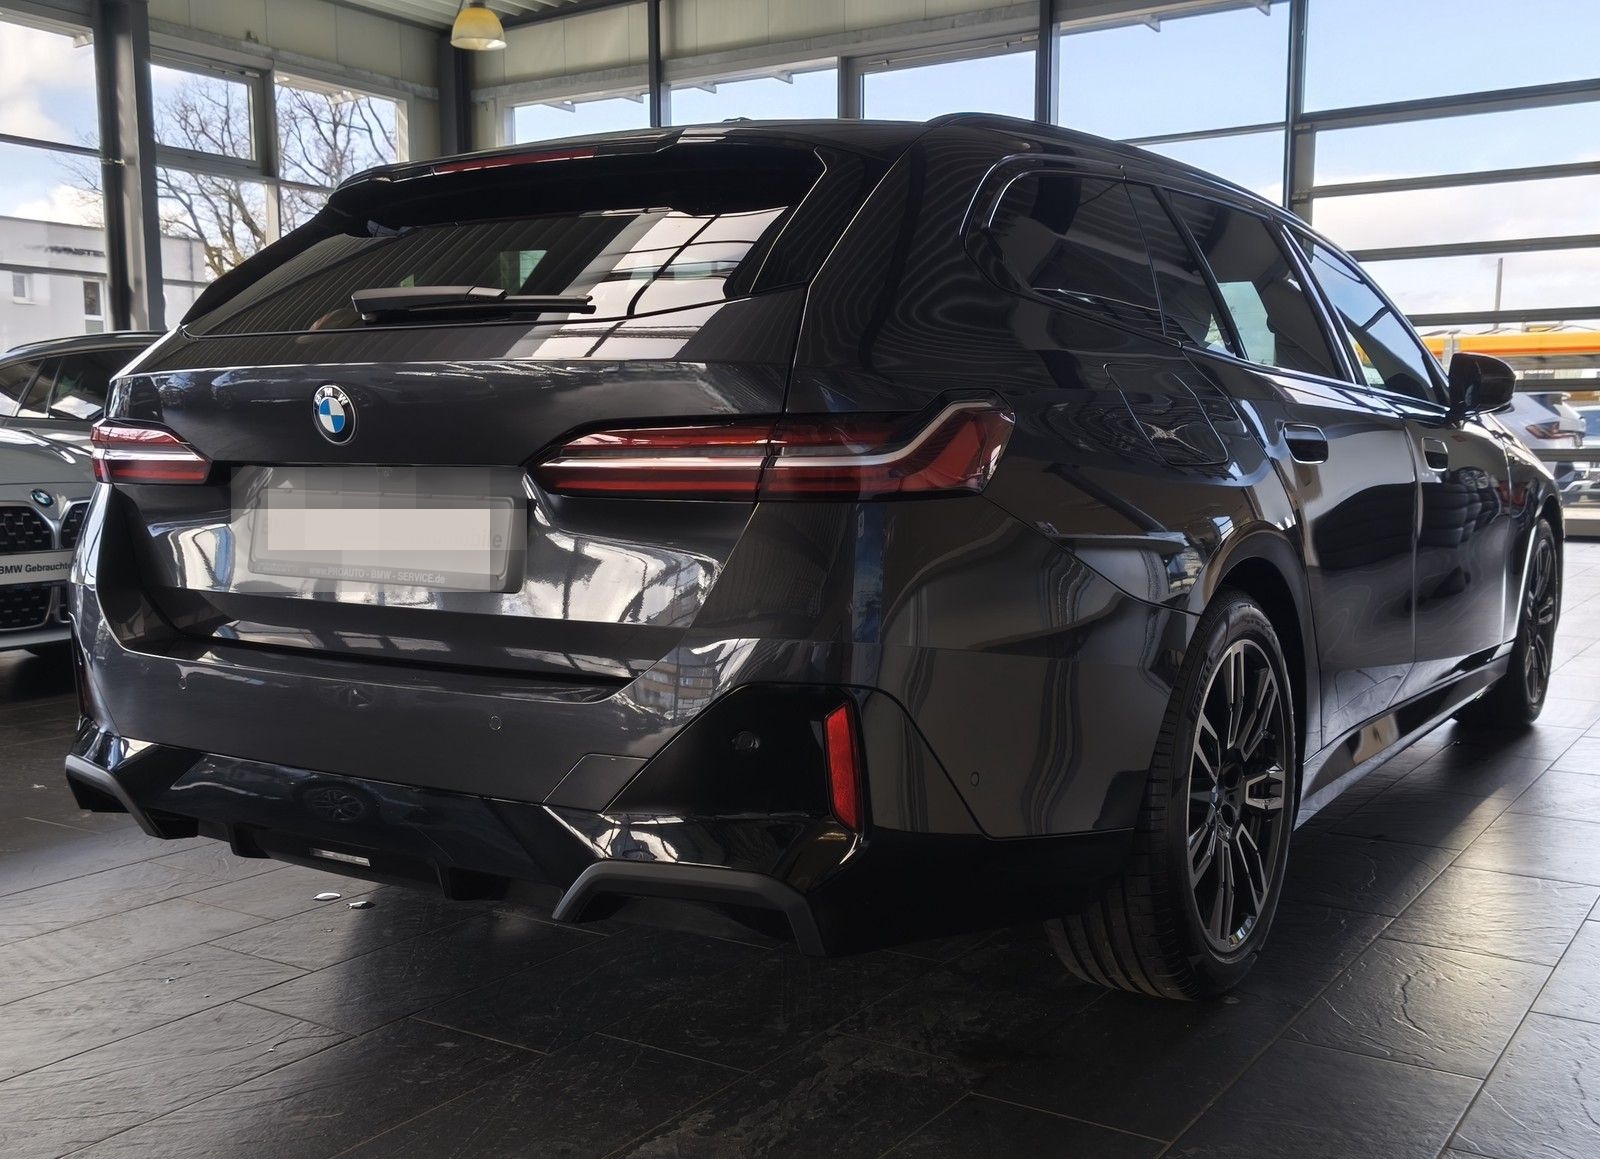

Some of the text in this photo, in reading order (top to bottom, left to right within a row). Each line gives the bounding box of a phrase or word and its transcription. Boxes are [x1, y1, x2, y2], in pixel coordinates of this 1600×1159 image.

[314, 387, 349, 406] BMW
[0, 565, 23, 575] BMW
[308, 566, 366, 578] www.PROAUTO
[370, 570, 392, 580] BMW
[397, 571, 446, 584] SERVICE.de
